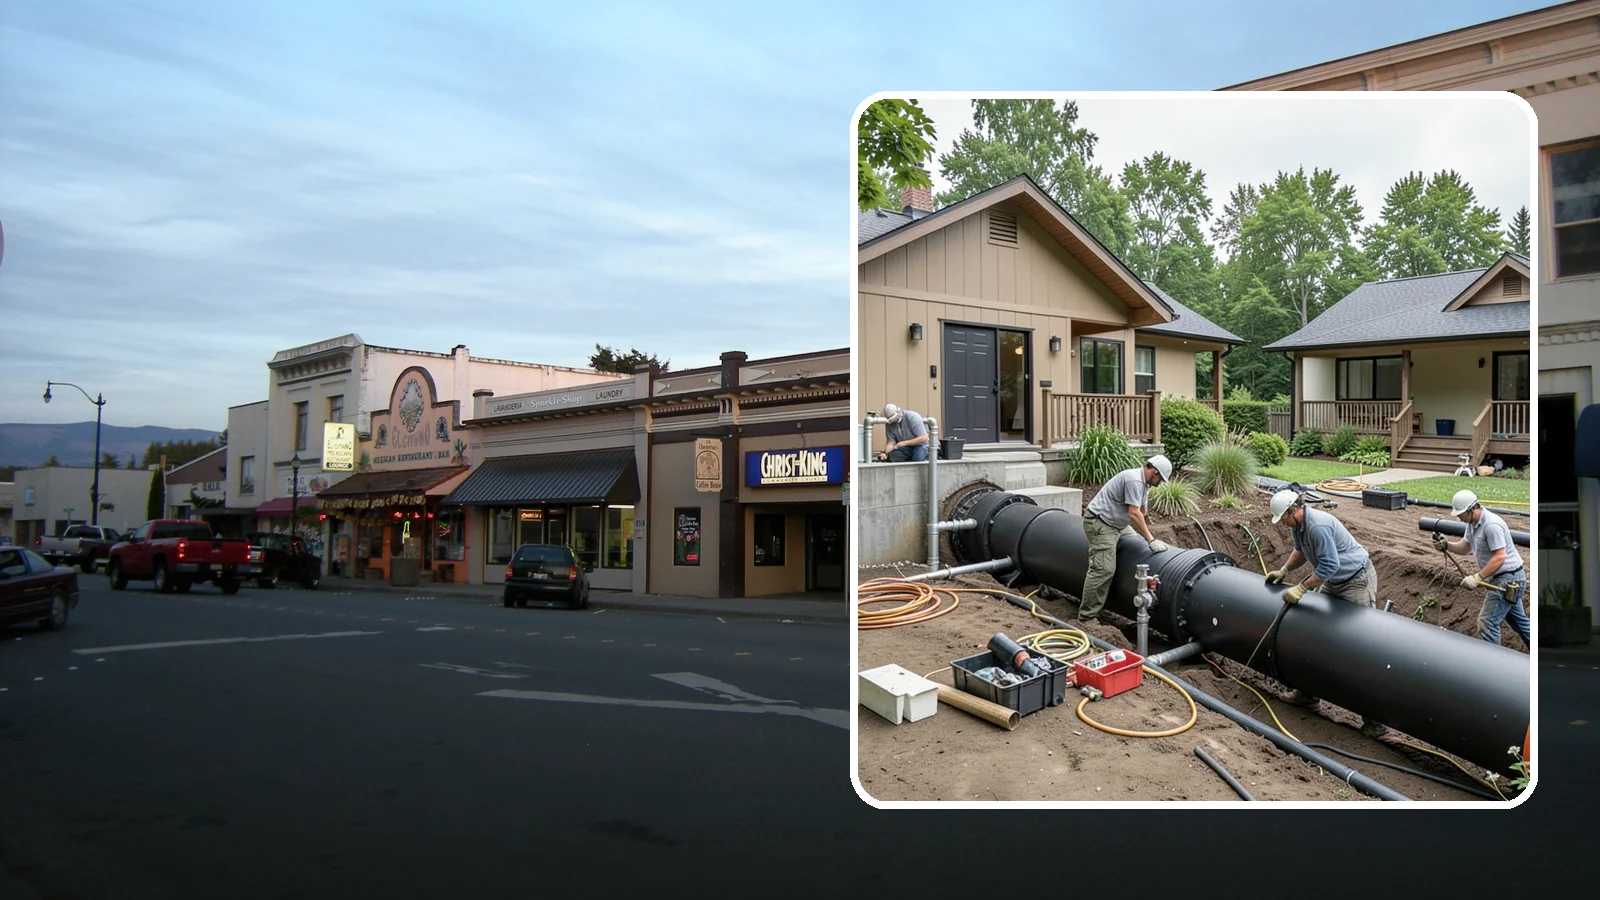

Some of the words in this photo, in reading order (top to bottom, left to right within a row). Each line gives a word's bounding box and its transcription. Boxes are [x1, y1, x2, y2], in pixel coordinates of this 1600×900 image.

[493, 402, 522, 412] LAVANDERIA
[561, 394, 582, 405] Shop
[595, 389, 623, 400] LAUNDRY
[397, 451, 434, 462] RESTAURANT
[438, 450, 450, 459] BAR
[761, 452, 798, 478] CHRIST
[799, 450, 827, 476] KING
